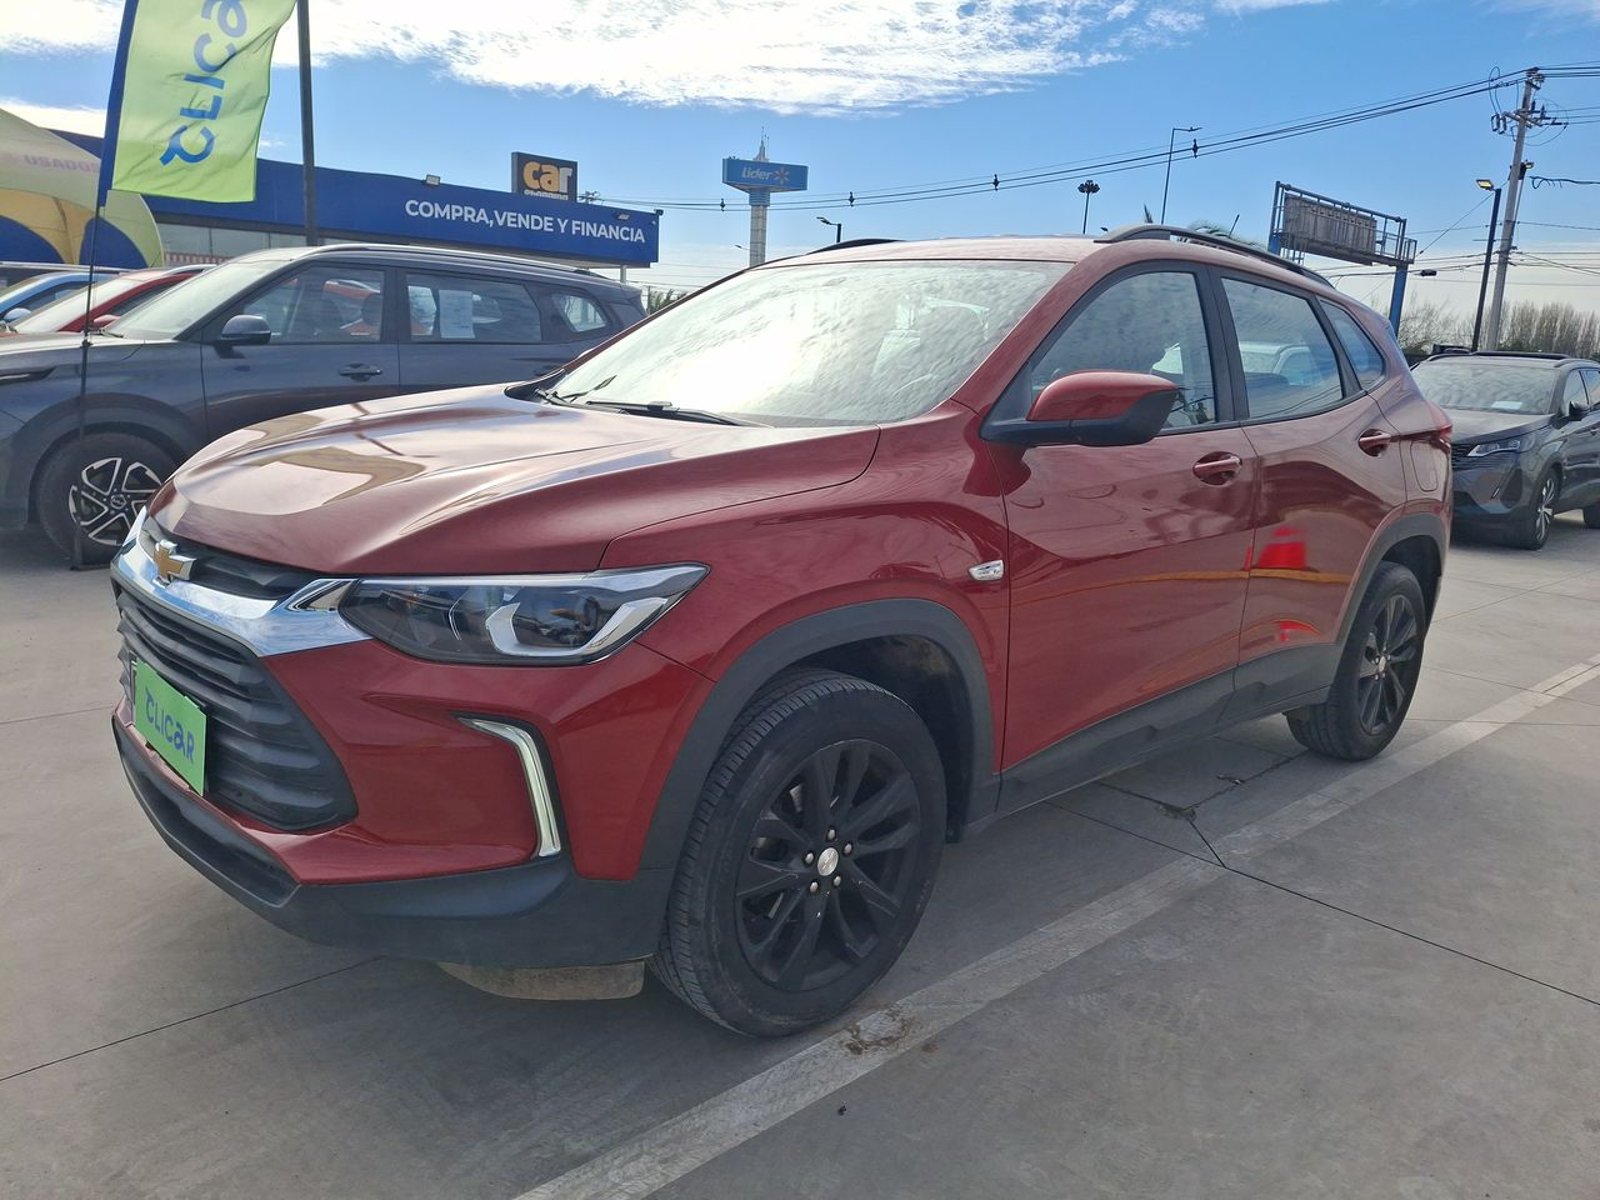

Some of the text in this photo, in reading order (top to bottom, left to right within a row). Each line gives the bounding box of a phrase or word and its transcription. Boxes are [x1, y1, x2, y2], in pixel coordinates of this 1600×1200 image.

[523, 161, 573, 193] car
[557, 218, 568, 234] Y
[571, 220, 645, 243] FINANCIA
